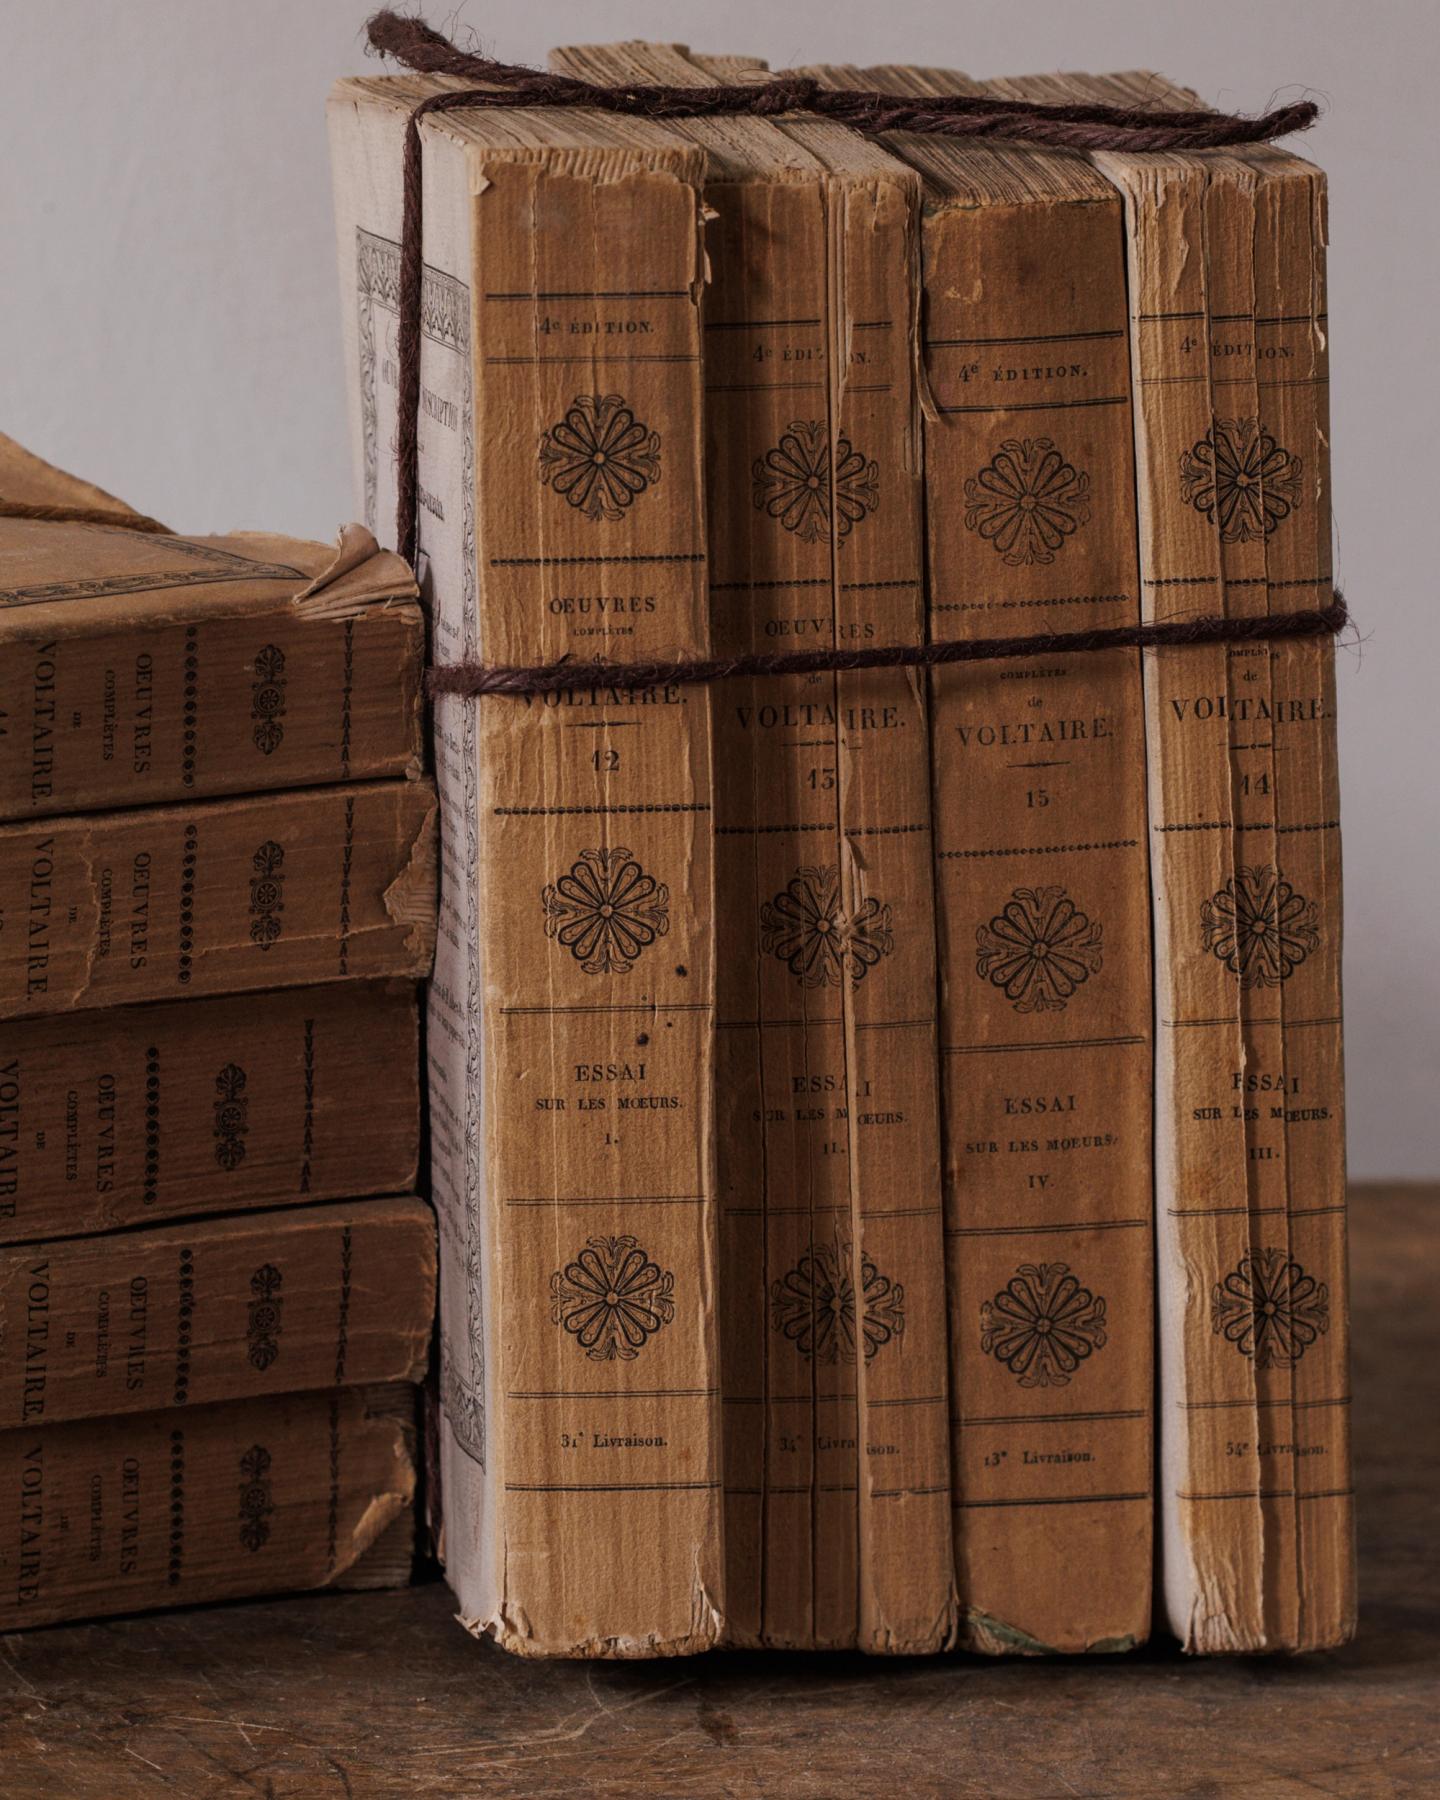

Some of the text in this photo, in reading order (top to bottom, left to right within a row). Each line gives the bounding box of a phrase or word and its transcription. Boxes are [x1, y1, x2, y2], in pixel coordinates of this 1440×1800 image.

[993, 364, 1089, 382] ÉDITION.
[736, 702, 906, 731] VOLTAIRE.
[1171, 695, 1332, 723] VOLTAIRE.
[955, 716, 1114, 748] VOLTAIRE.
[591, 749, 620, 771] 12
[807, 768, 835, 790] 13
[1240, 773, 1271, 796] 14
[1026, 789, 1050, 808] 15
[27, 838, 55, 1001] VOLTAIRE.
[575, 1063, 646, 1083] ESSAI
[535, 1098, 566, 1111] SUR
[578, 1098, 606, 1111] LES
[1004, 1094, 1077, 1115] ESSAI
[1193, 1107, 1222, 1121] SUR
[965, 1141, 998, 1154] SUR
[1008, 1139, 1039, 1153] LES
[593, 1432, 668, 1448] Livraison.
